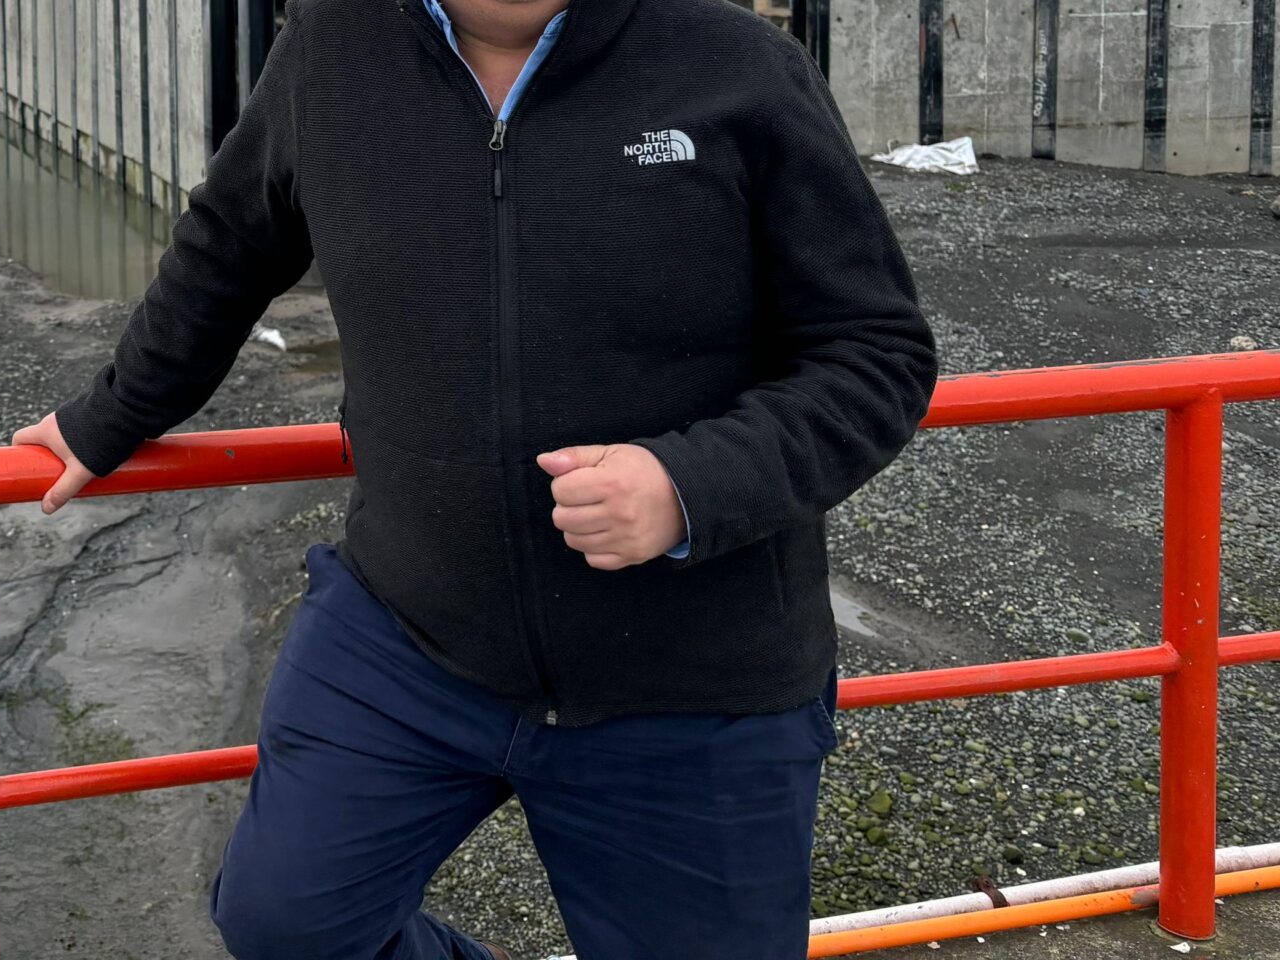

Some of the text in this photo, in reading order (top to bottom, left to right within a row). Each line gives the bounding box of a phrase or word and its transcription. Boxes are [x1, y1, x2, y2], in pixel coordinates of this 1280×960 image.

[641, 130, 669, 141] THE
[624, 141, 670, 156] NORTH
[638, 152, 671, 165] FACE
